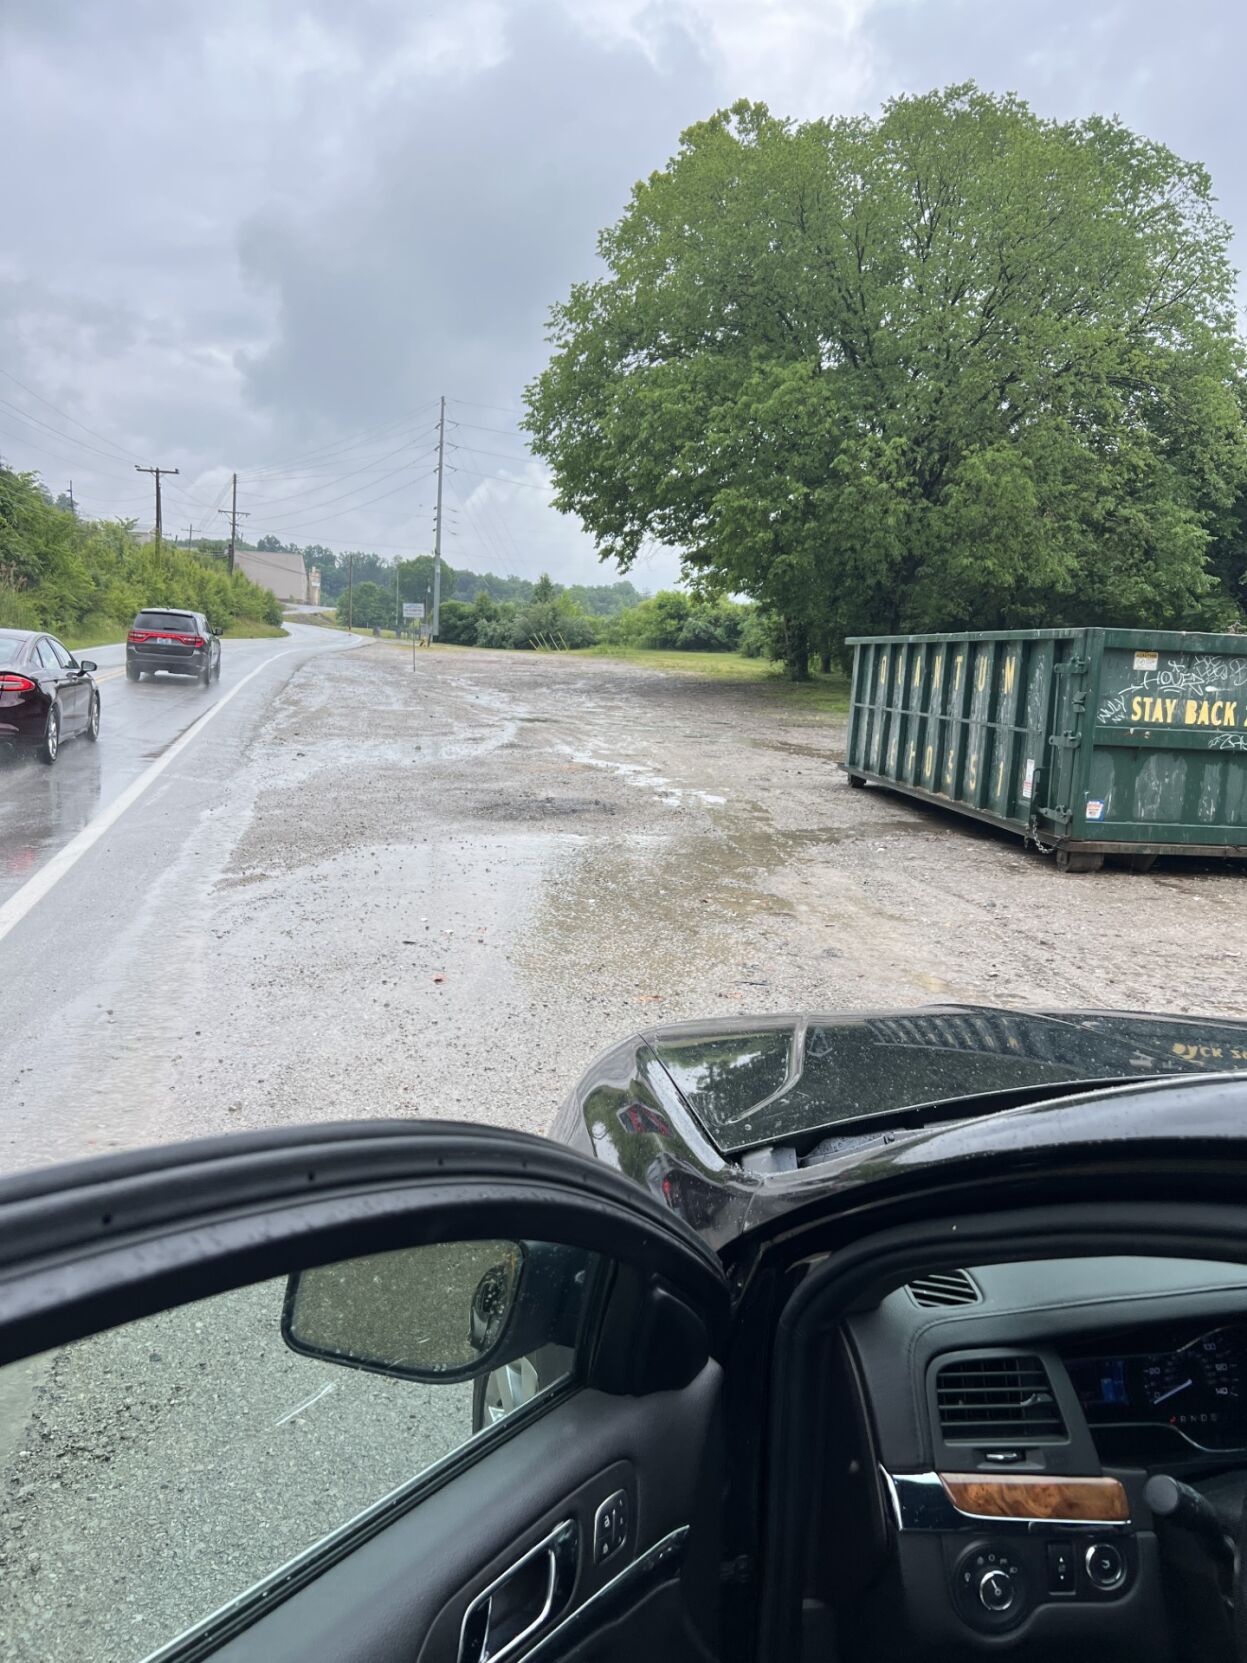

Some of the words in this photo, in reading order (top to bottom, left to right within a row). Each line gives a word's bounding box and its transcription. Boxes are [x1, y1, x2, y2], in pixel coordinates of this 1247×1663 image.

[1131, 696, 1177, 723] STAY
[1185, 699, 1237, 727] BACK
[1200, 1413, 1208, 1422] D
